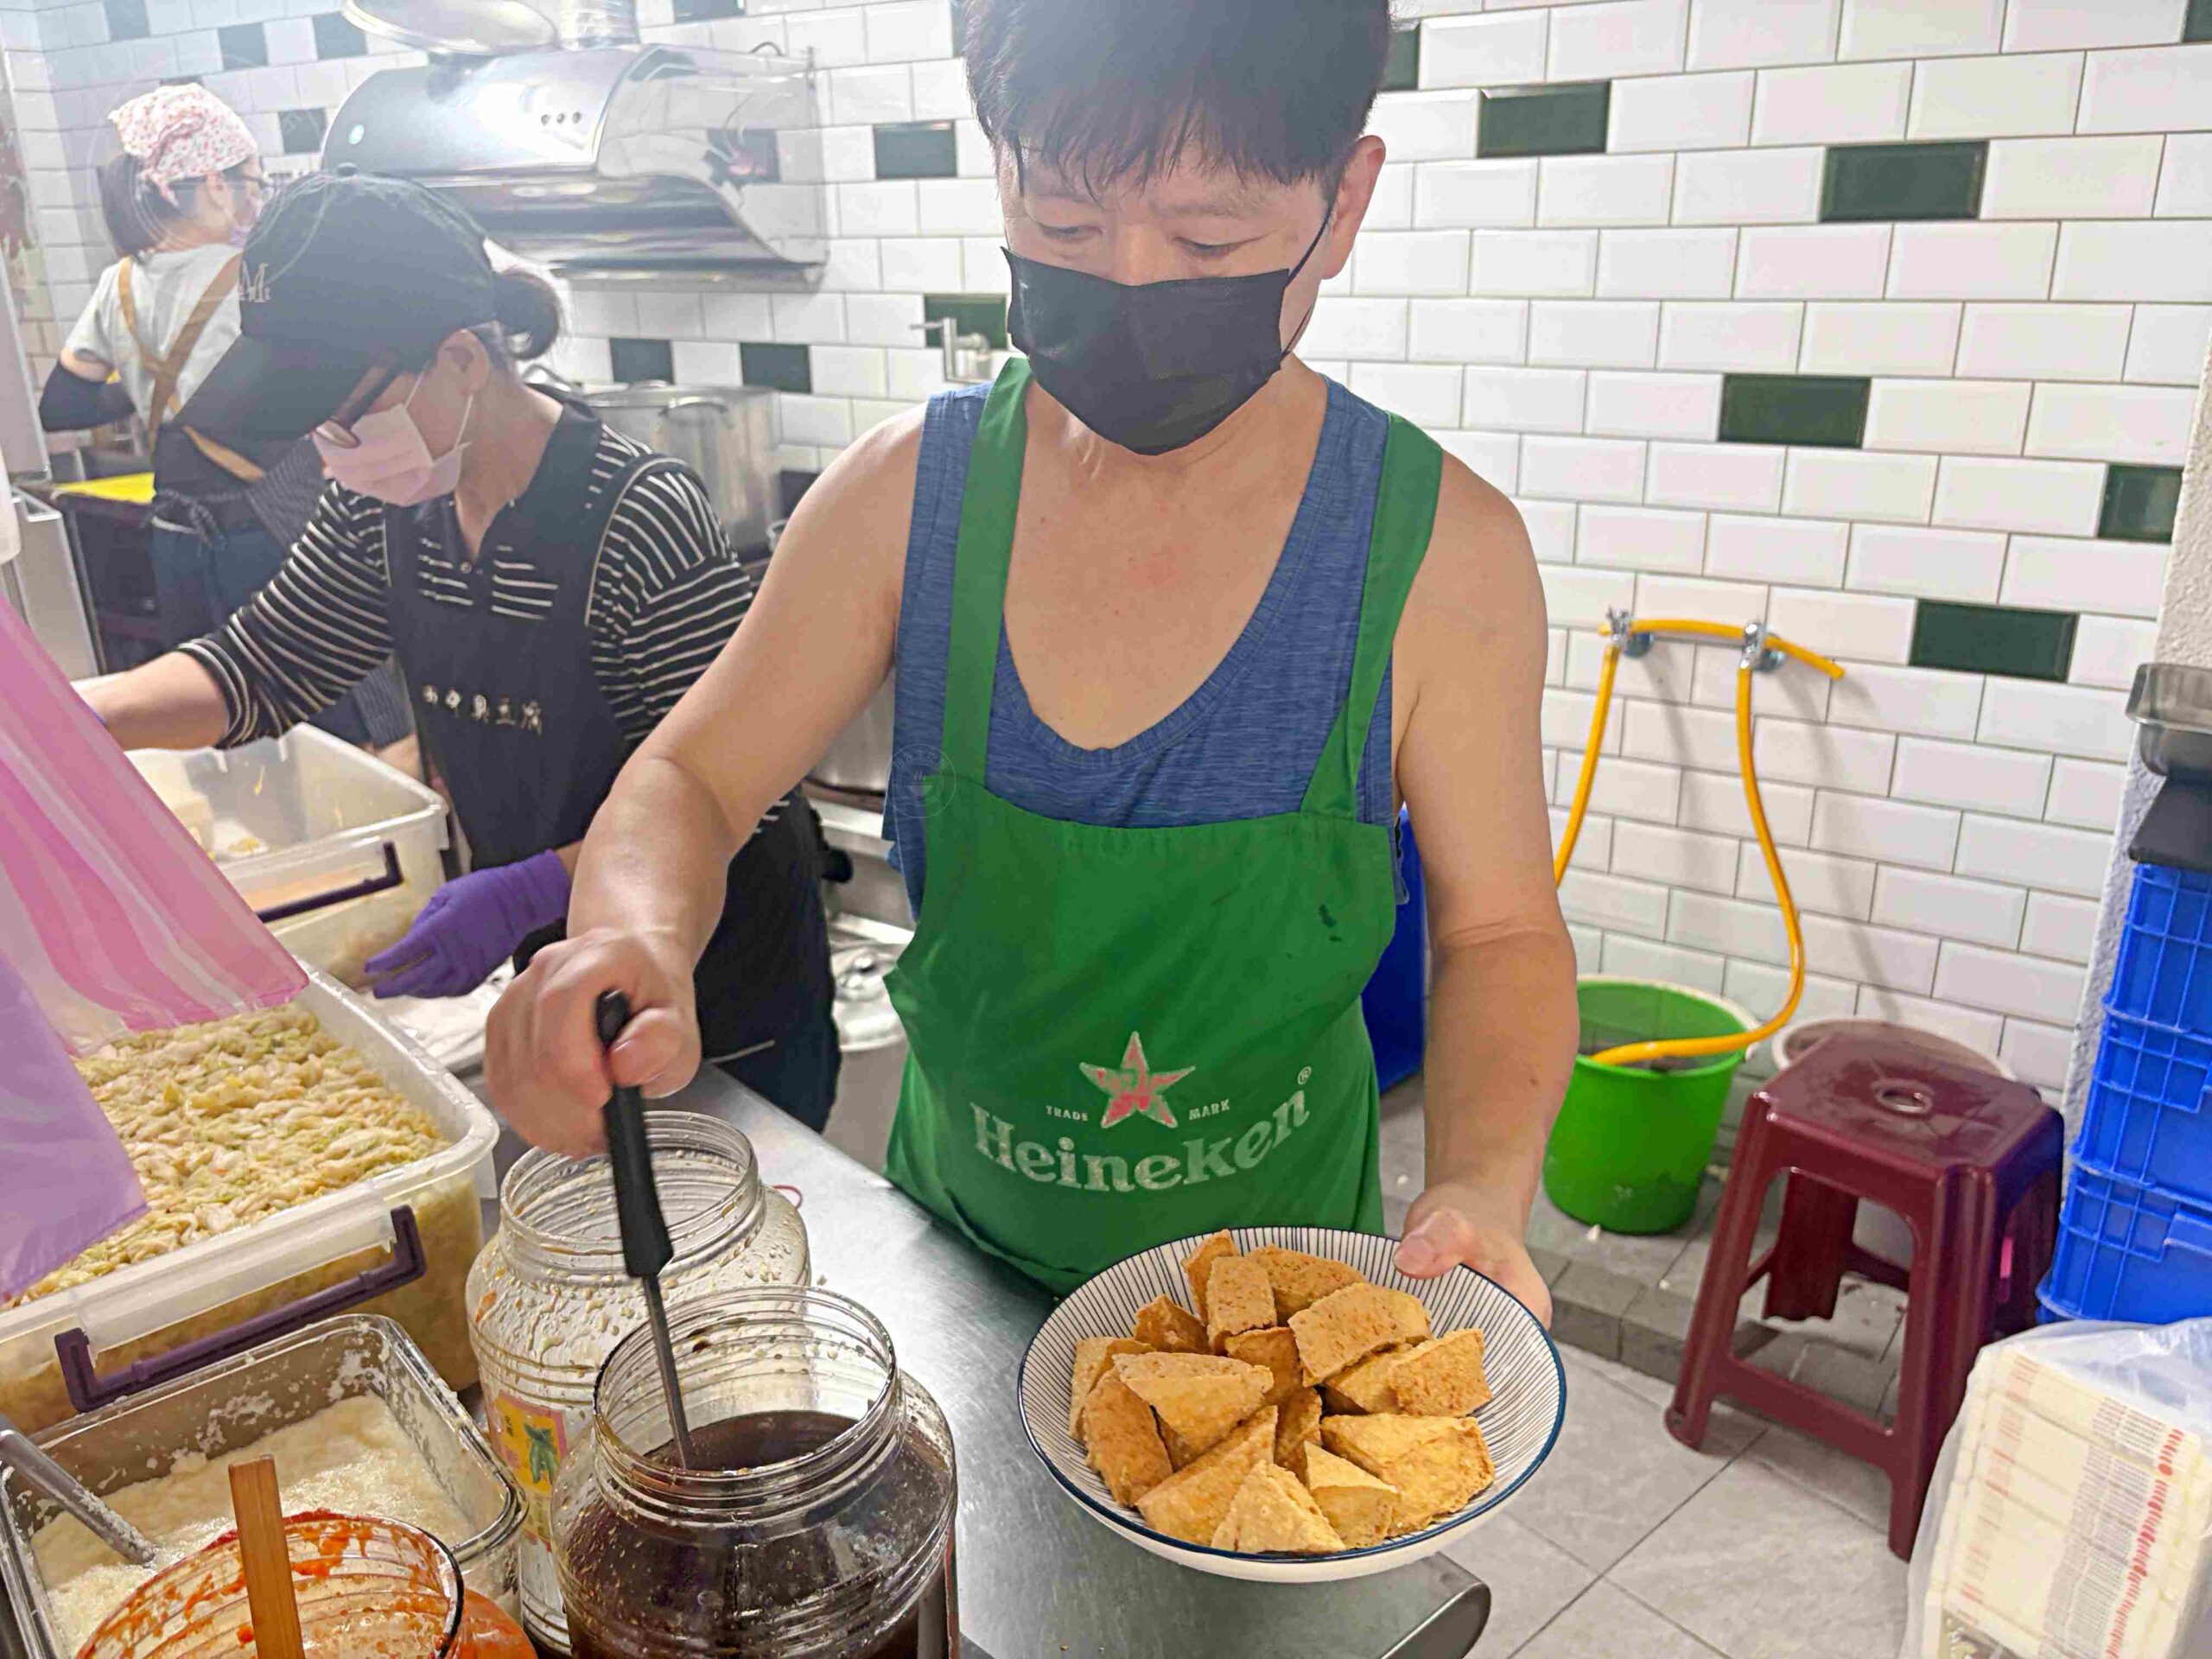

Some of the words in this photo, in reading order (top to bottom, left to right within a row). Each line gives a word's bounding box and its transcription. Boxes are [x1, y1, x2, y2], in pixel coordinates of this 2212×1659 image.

[970, 1090, 1310, 1192] Heineken
[1046, 1104, 1089, 1122] TRADE
[1188, 1098, 1230, 1121] MARK
